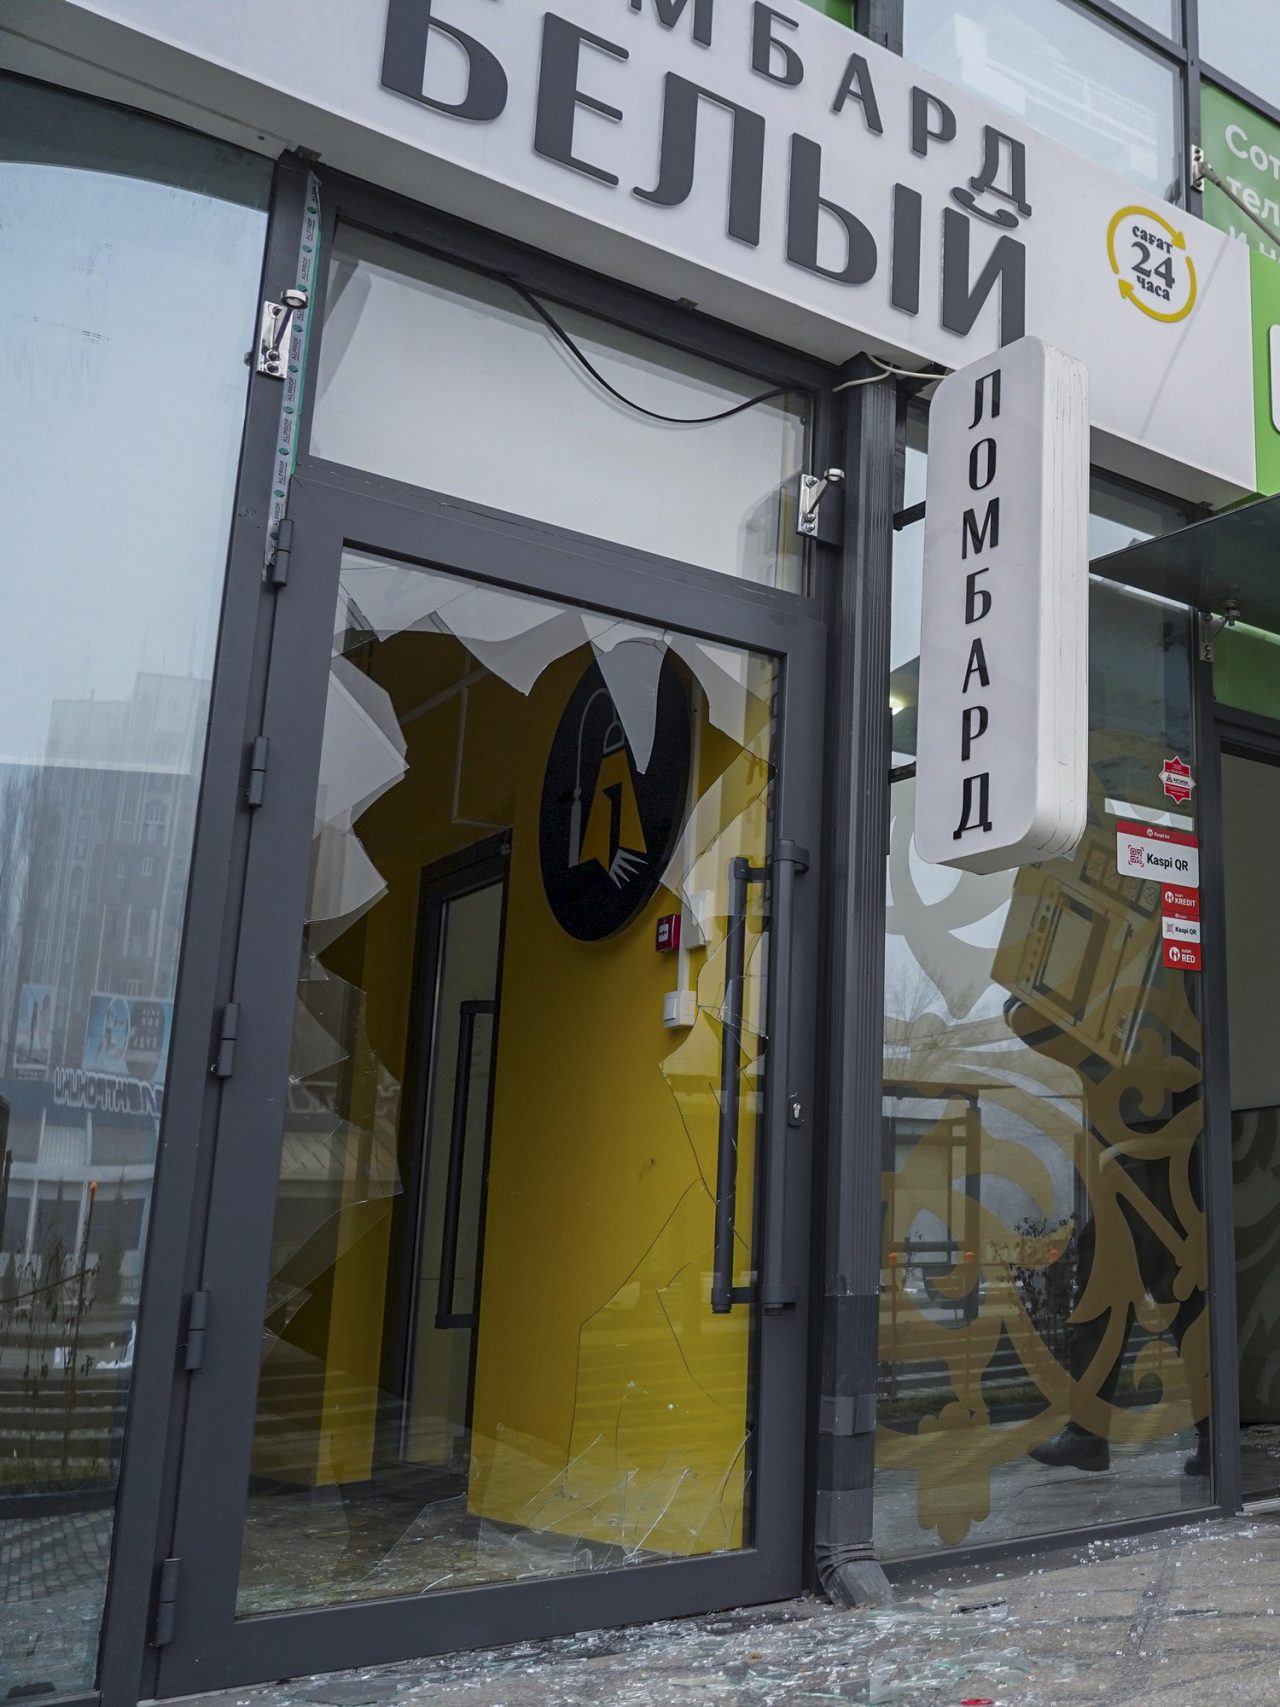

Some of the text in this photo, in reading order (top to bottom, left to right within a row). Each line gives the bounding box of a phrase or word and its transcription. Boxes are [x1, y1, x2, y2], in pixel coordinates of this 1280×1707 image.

[380, 0, 1028, 350] БЕЛЫЙ
[1131, 241, 1175, 290] 24
[1136, 274, 1171, 302] часа
[953, 368, 1001, 840] ЛОМБАРД
[1147, 853, 1188, 871] Kaspi QR
[1174, 897, 1196, 908] KREDIT
[1175, 925, 1188, 935] Kaspi
[1181, 954, 1196, 964] RED
